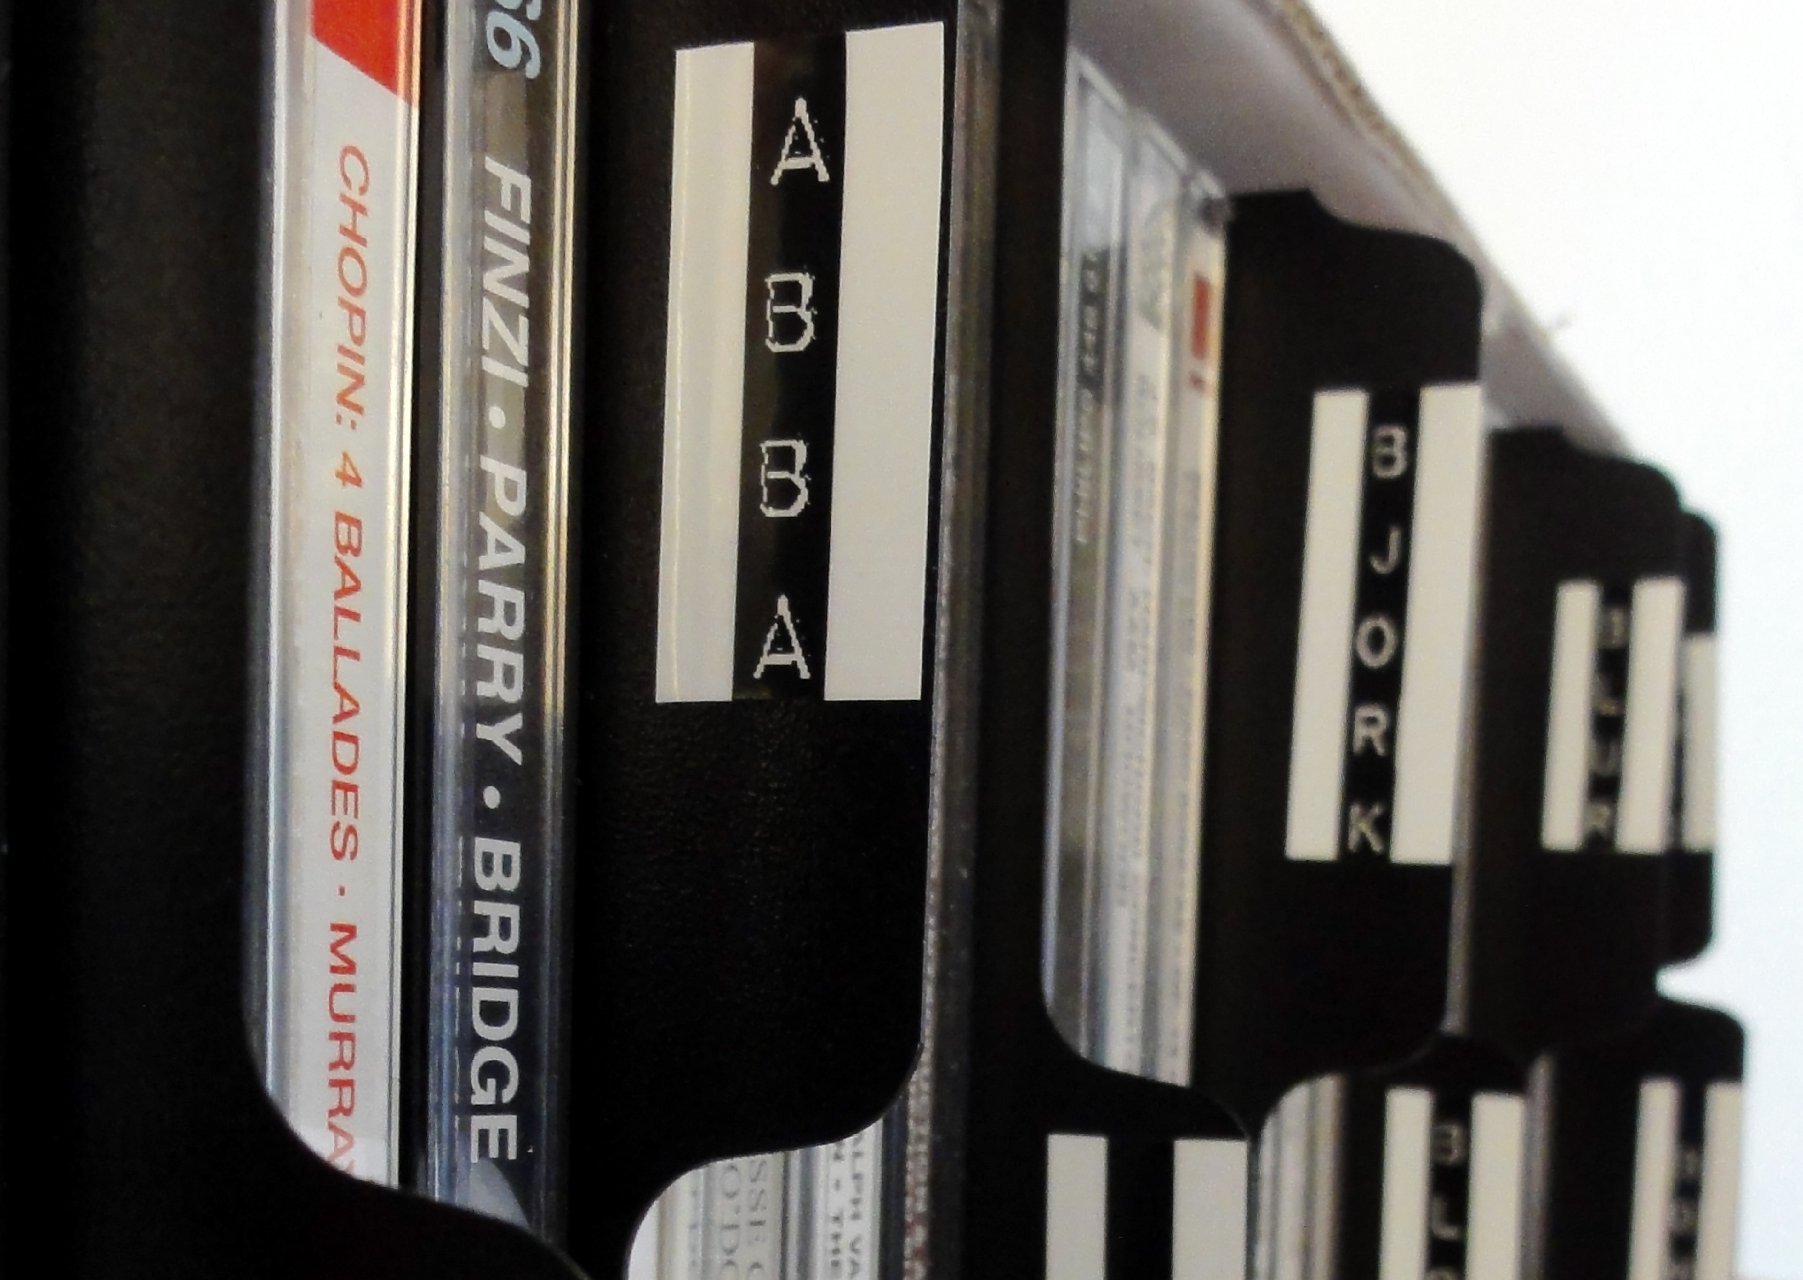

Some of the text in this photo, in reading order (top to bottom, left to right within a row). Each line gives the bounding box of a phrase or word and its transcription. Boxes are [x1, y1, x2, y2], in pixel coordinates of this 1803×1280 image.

[326, 144, 371, 1177] CHOPIN: 4 BALLADES MURRA
[470, 155, 532, 1164] FINZI PARRY BRIDGE
[753, 96, 830, 681] ABBA
[1345, 424, 1411, 856] BJORK
[829, 1211, 845, 1280] THE
